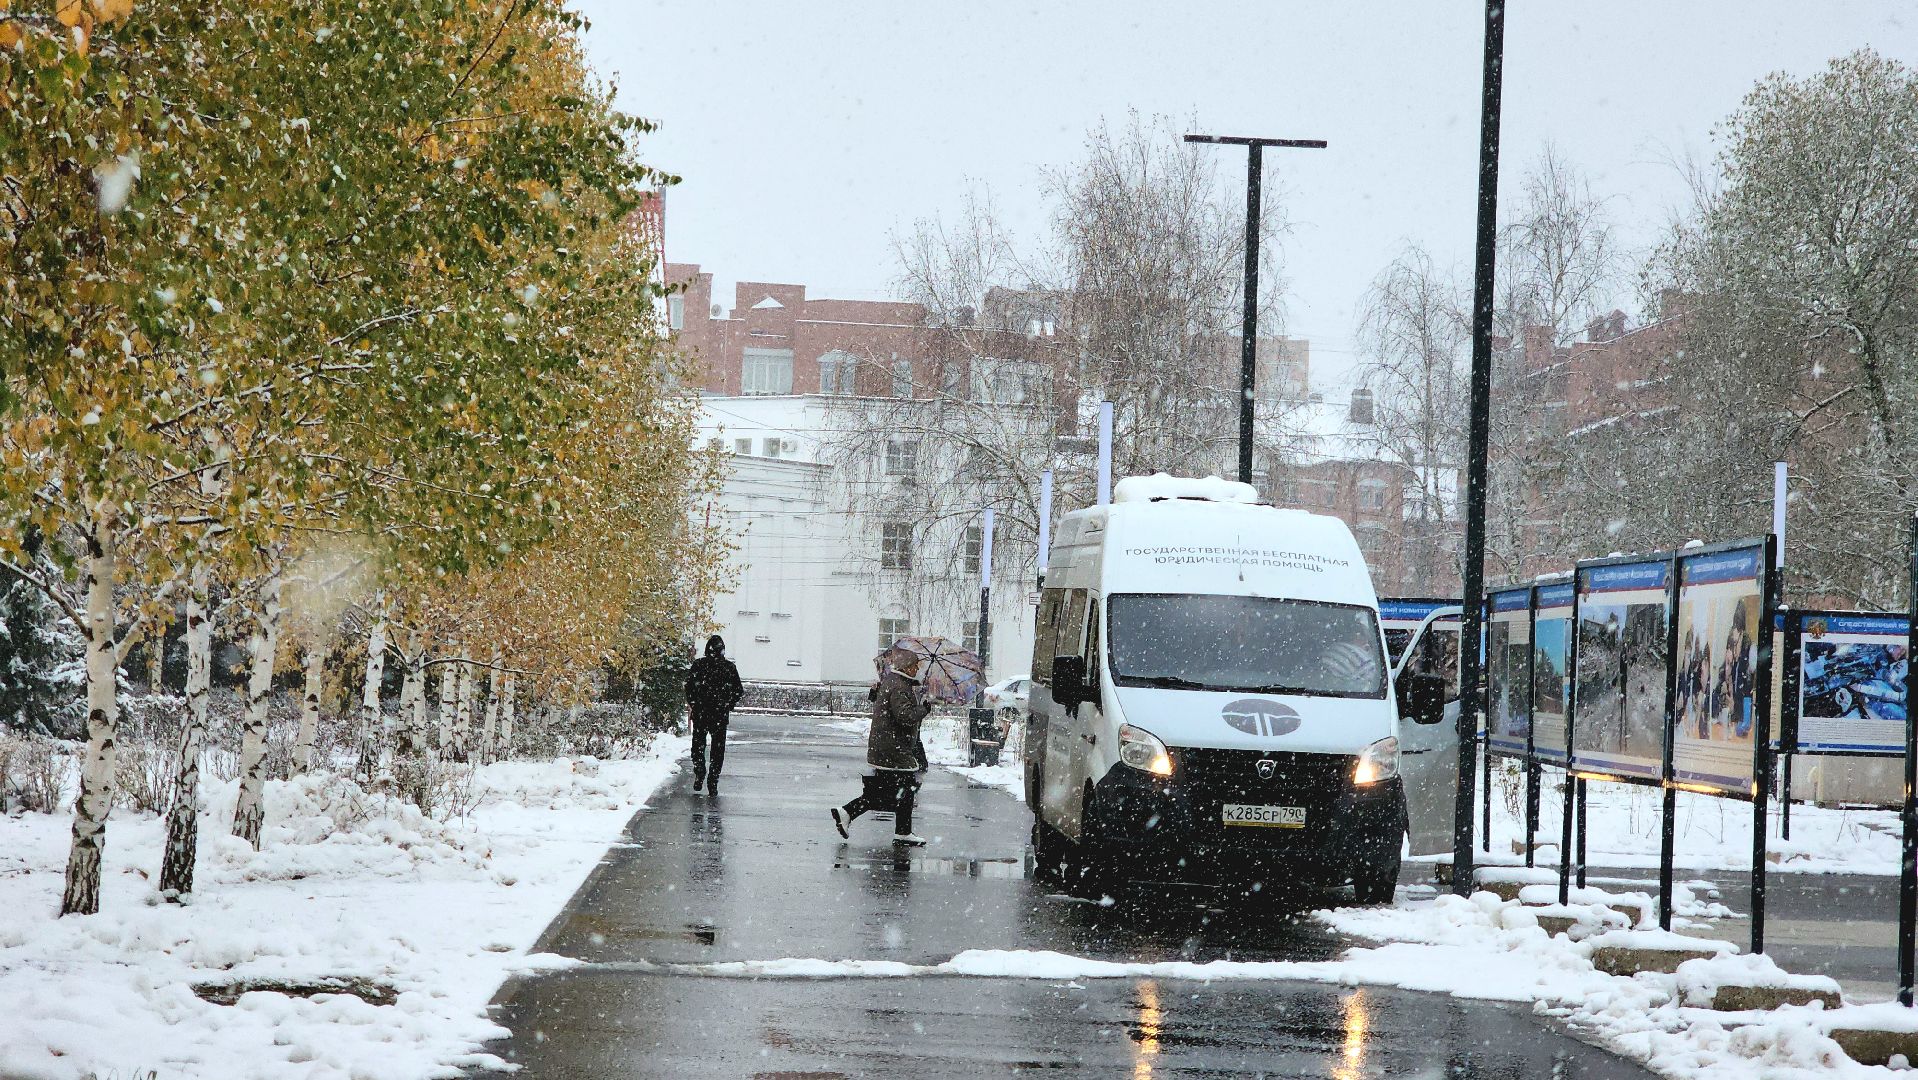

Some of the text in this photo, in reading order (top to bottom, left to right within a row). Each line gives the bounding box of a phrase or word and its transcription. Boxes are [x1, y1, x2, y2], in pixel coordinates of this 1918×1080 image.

[1125, 546, 1349, 567] ГОСУДАРСТВЕННАЯ БЕСПЛАТНАЯ
[1155, 556, 1324, 573] ЮРИДИЧЕСКАЯ ПОМОЩЬ
[1227, 806, 1302, 822] К285СР 790
